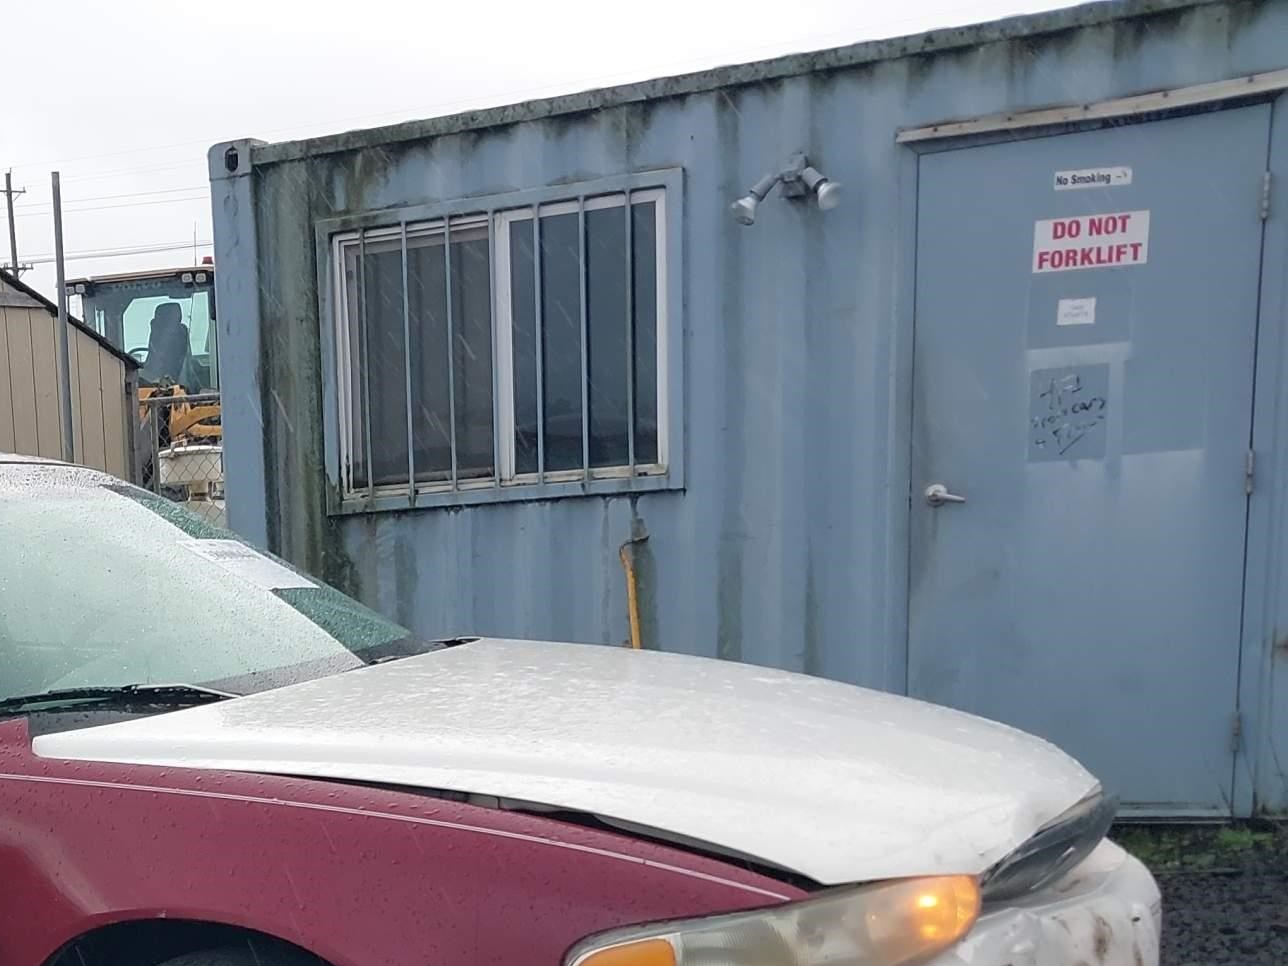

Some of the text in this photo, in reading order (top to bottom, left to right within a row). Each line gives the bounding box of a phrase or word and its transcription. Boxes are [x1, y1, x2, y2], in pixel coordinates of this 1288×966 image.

[1055, 172, 1112, 186] No Smoking
[1052, 214, 1131, 240] DO NOT
[1037, 242, 1143, 270] FORKLIFT
